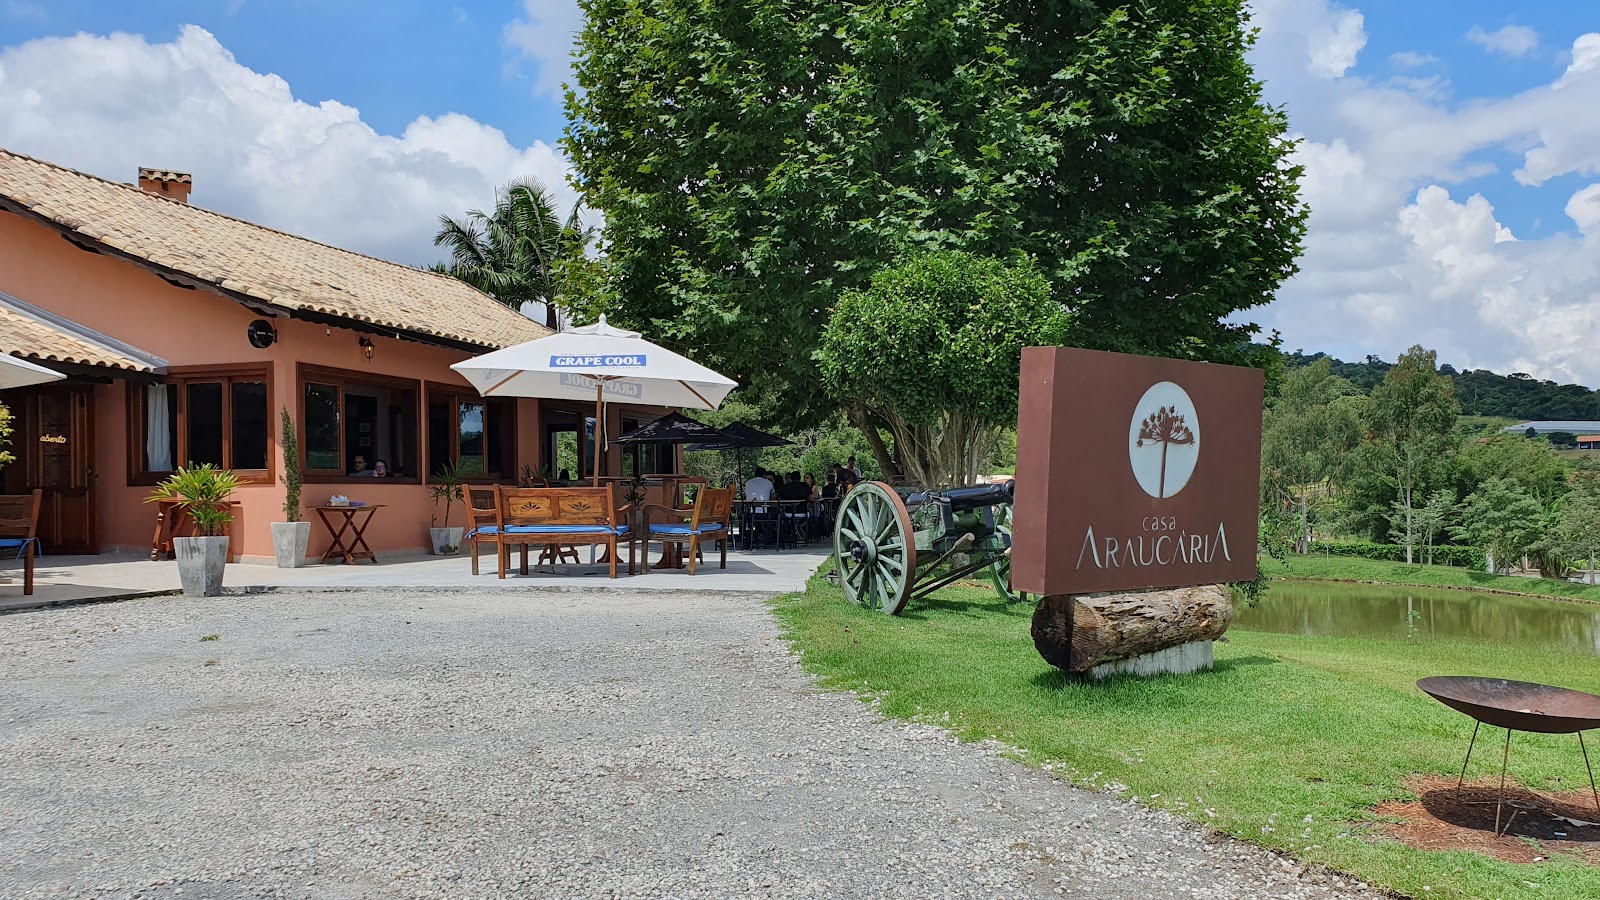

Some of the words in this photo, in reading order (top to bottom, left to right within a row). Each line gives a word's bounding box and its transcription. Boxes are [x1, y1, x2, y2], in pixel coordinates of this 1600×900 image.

[555, 357, 602, 366] GRAPE
[605, 356, 641, 365] COOL
[40, 433, 67, 444] aberto
[1142, 516, 1176, 531] casa
